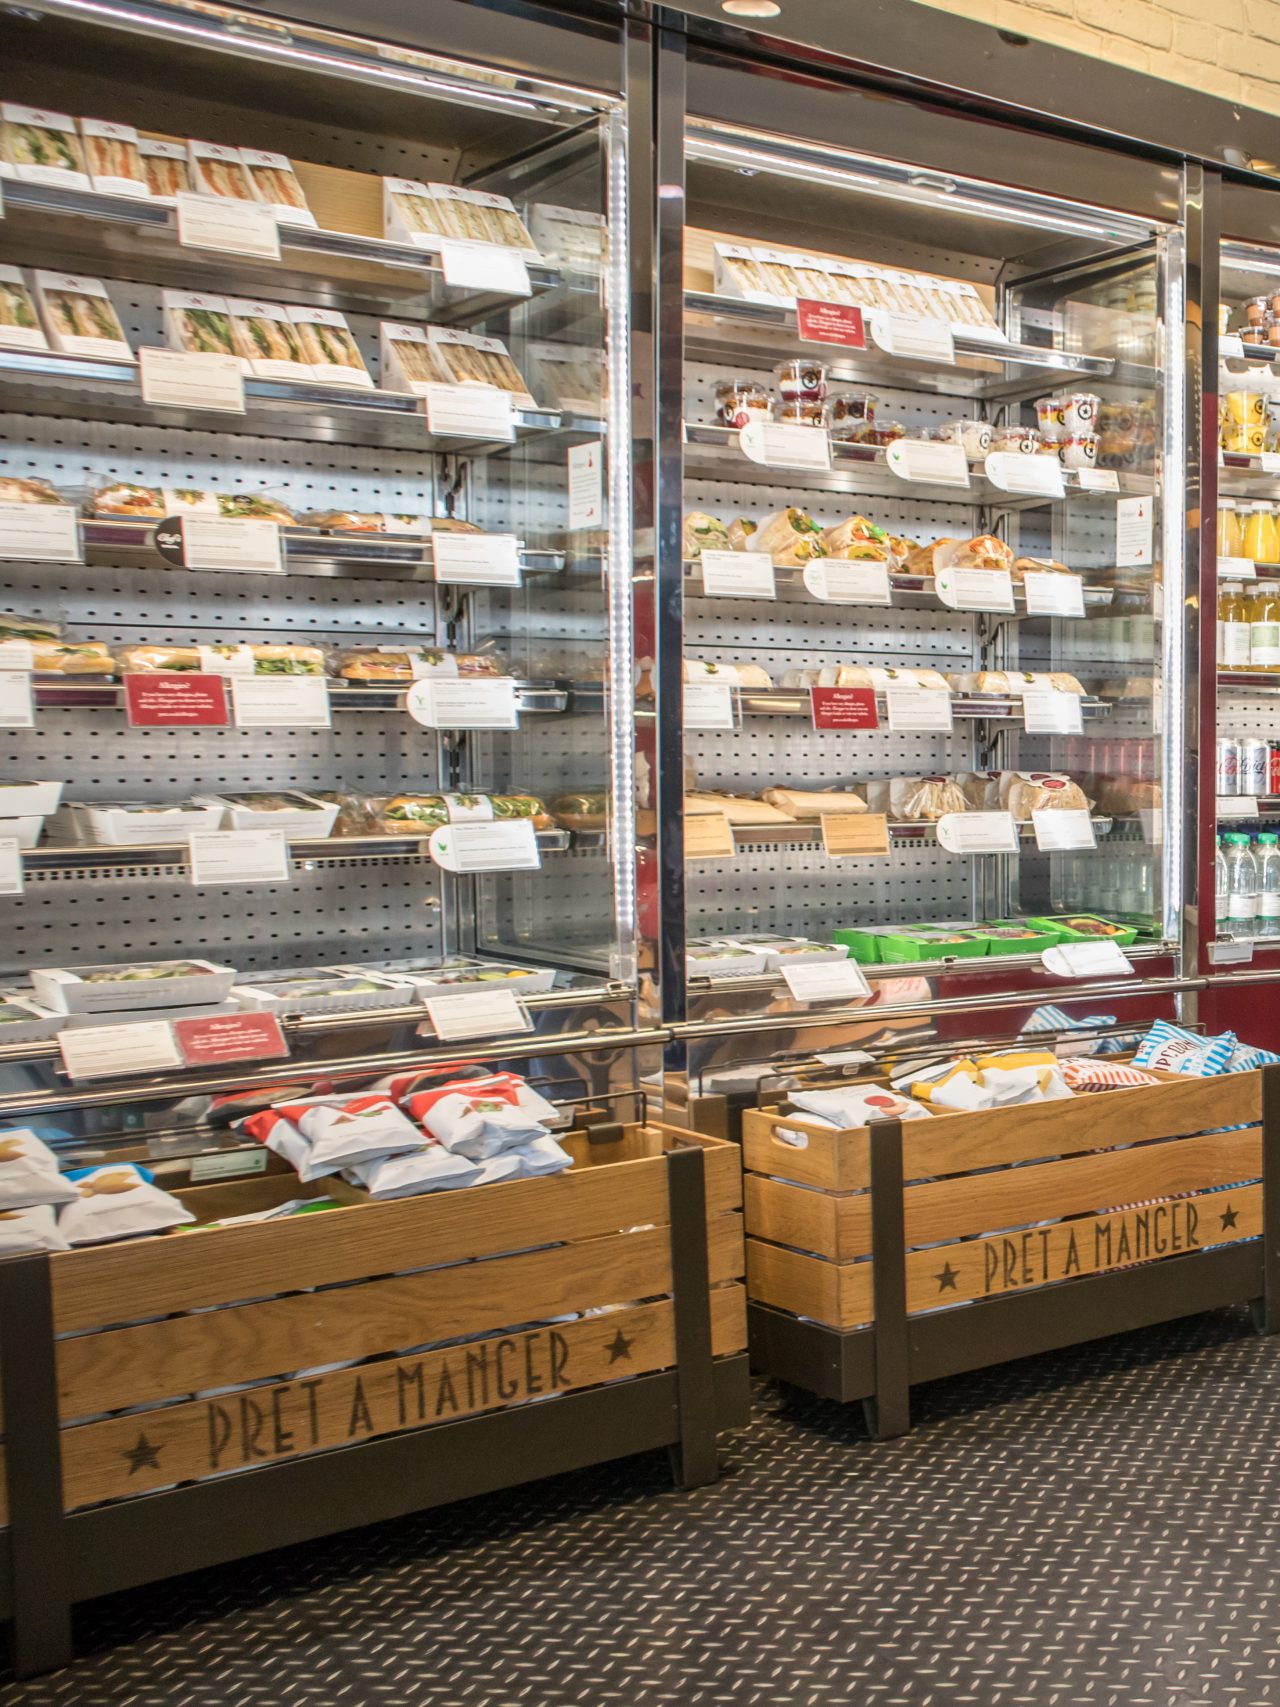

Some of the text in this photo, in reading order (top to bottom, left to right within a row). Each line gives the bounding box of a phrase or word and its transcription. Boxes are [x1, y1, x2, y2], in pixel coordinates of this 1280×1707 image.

[984, 1202, 1199, 1293] PRET A MANGER
[208, 1331, 572, 1468] PRET A MANGER
